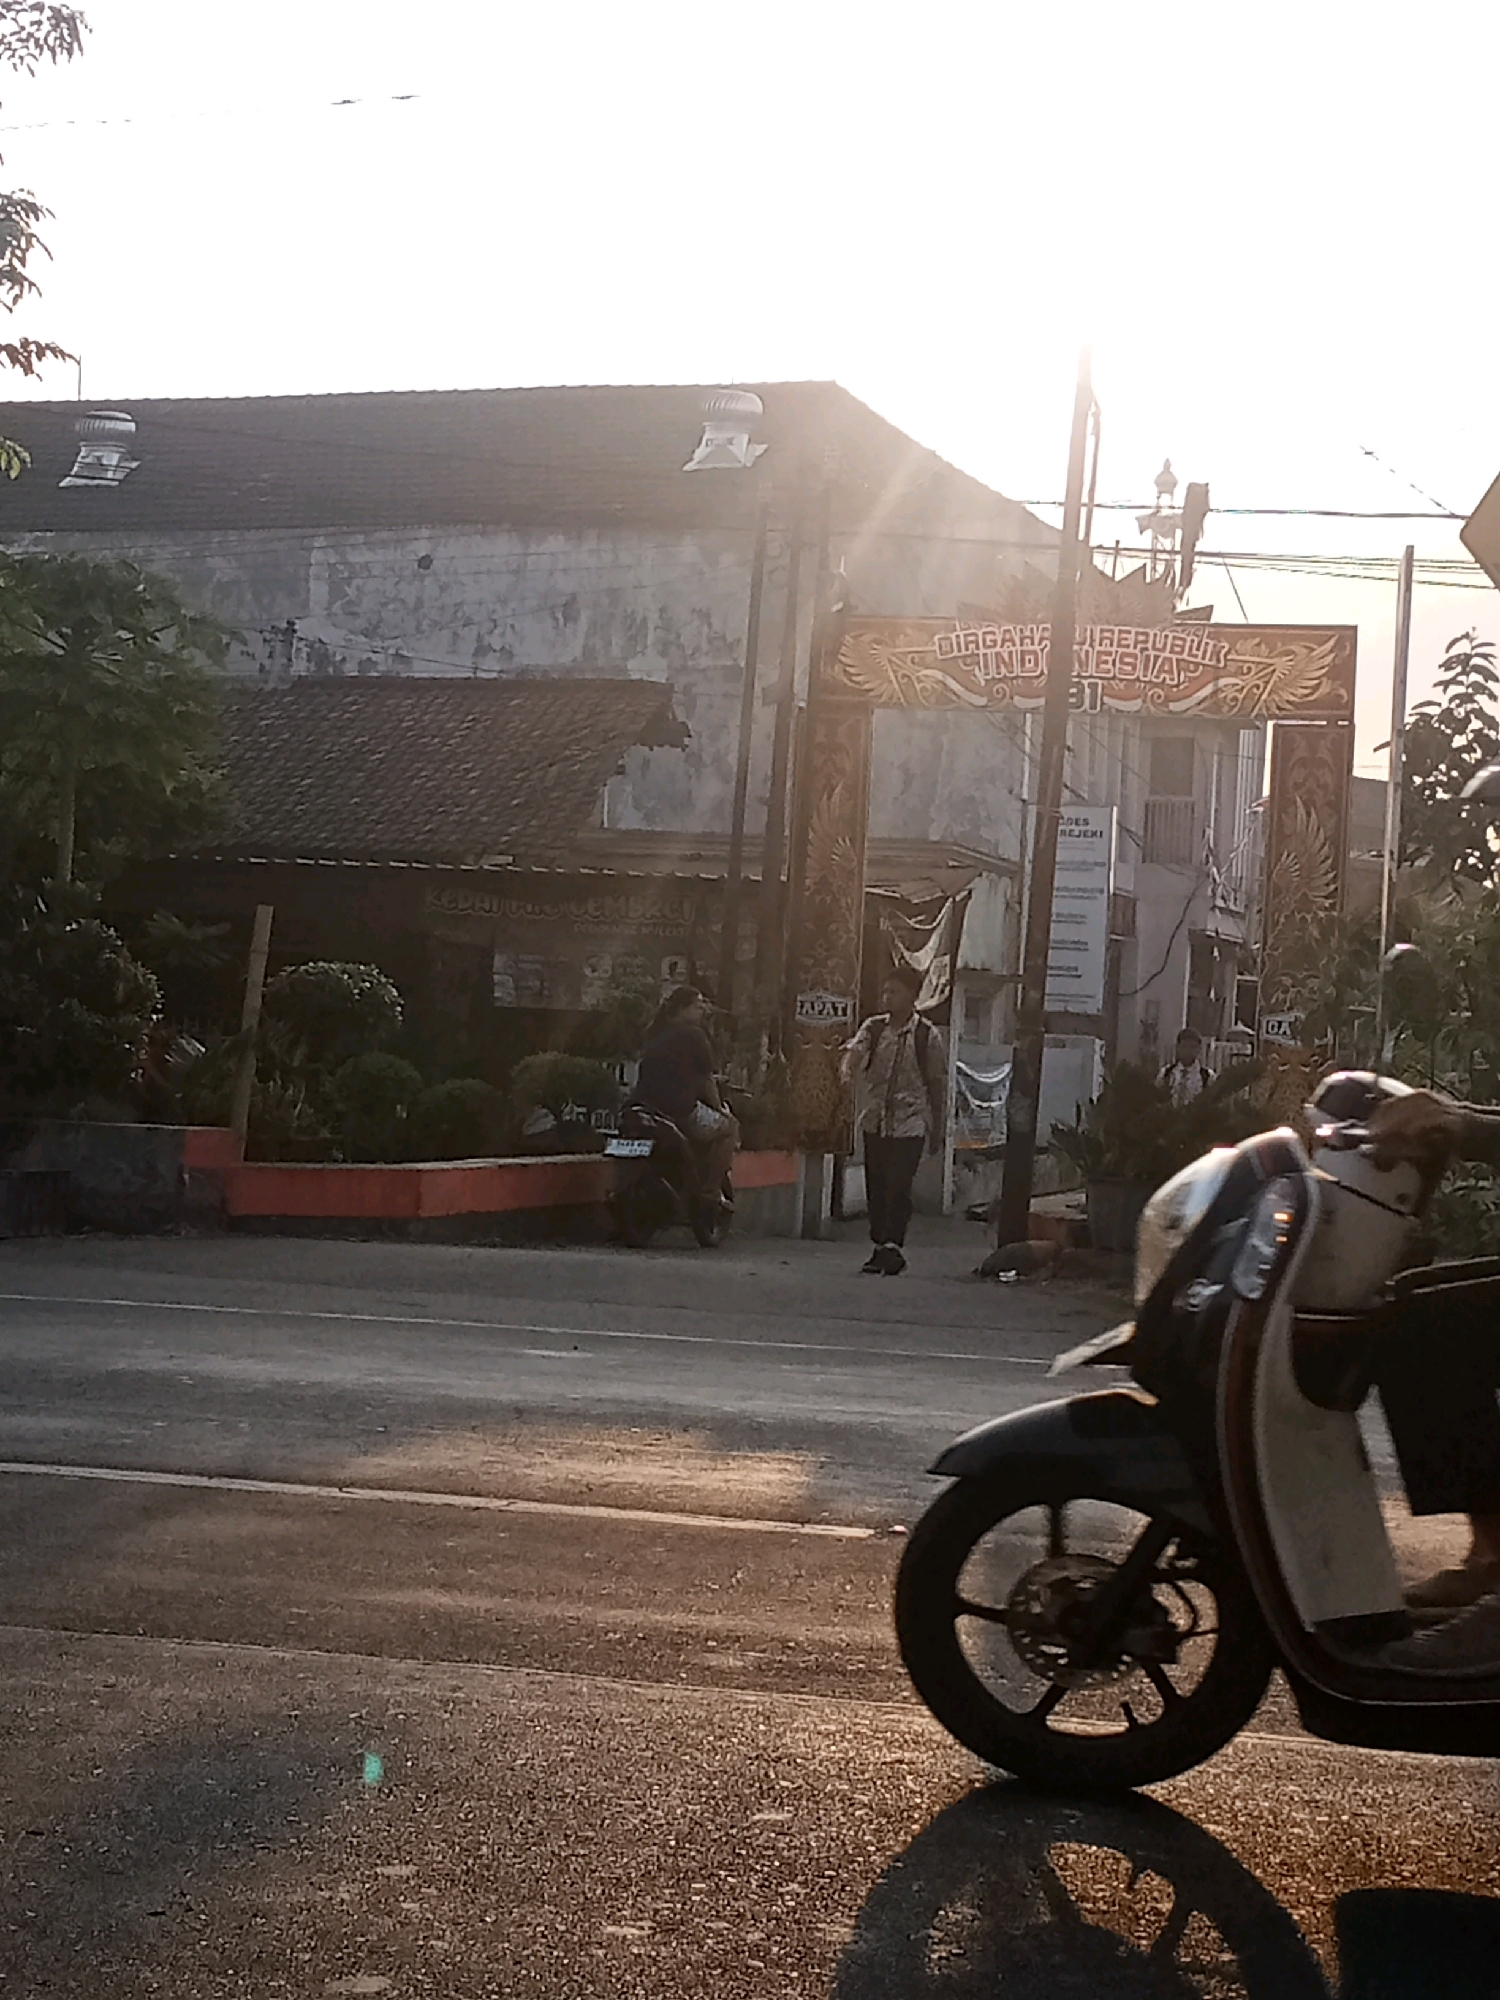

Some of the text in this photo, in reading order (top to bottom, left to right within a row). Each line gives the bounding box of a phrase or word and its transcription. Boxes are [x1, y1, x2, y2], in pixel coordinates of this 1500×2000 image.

[934, 624, 1229, 667] DIRGAHAU REPUBLIK
[980, 648, 1178, 684] INDNESIA
